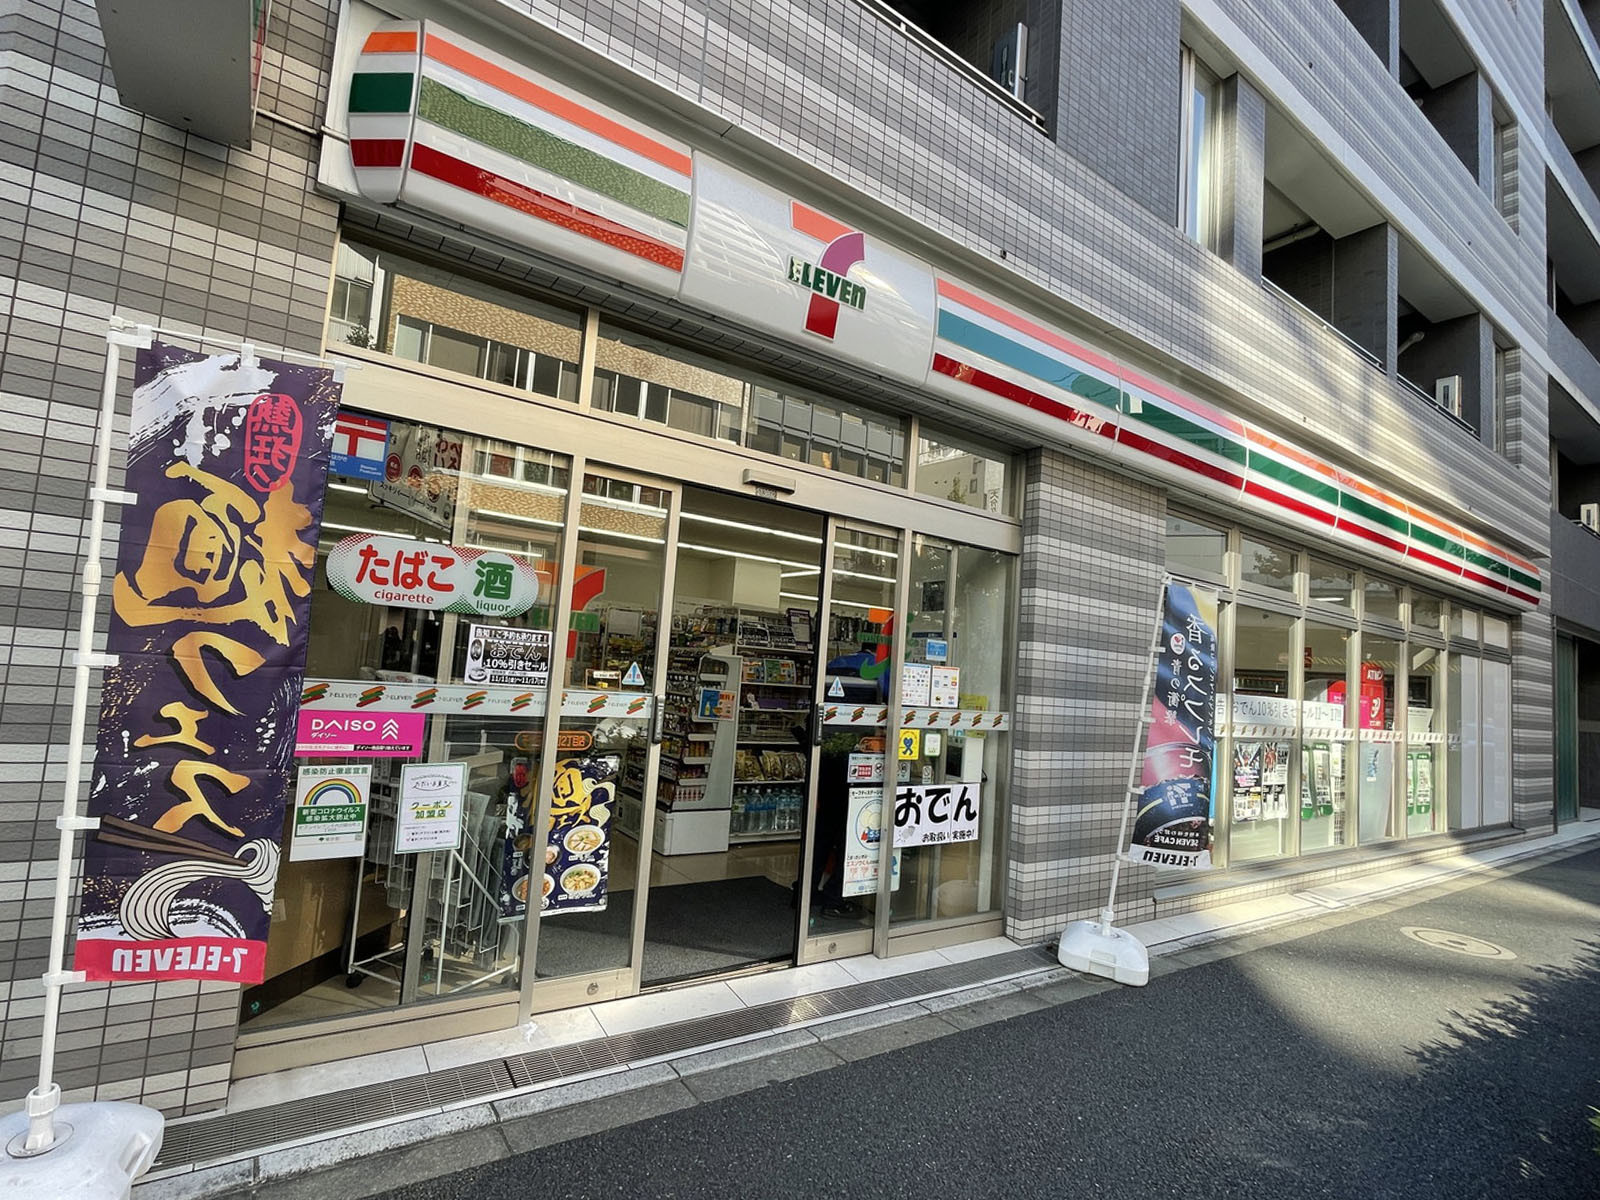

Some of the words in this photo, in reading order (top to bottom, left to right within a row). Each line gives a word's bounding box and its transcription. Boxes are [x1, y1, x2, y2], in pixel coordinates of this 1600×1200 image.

[355, 543, 455, 593] たばこ
[472, 558, 515, 602] 酒
[373, 588, 434, 605] cigarette
[475, 600, 511, 614] liquor
[490, 642, 542, 661] おでん
[486, 657, 548, 672] 10%引きセール
[311, 718, 377, 732] DAISO
[311, 731, 338, 739] ダイソー
[302, 806, 361, 817] 新型コロナウイルス
[410, 799, 453, 810] クーポン
[894, 785, 978, 828] おでん
[415, 809, 447, 820] 加盟店
